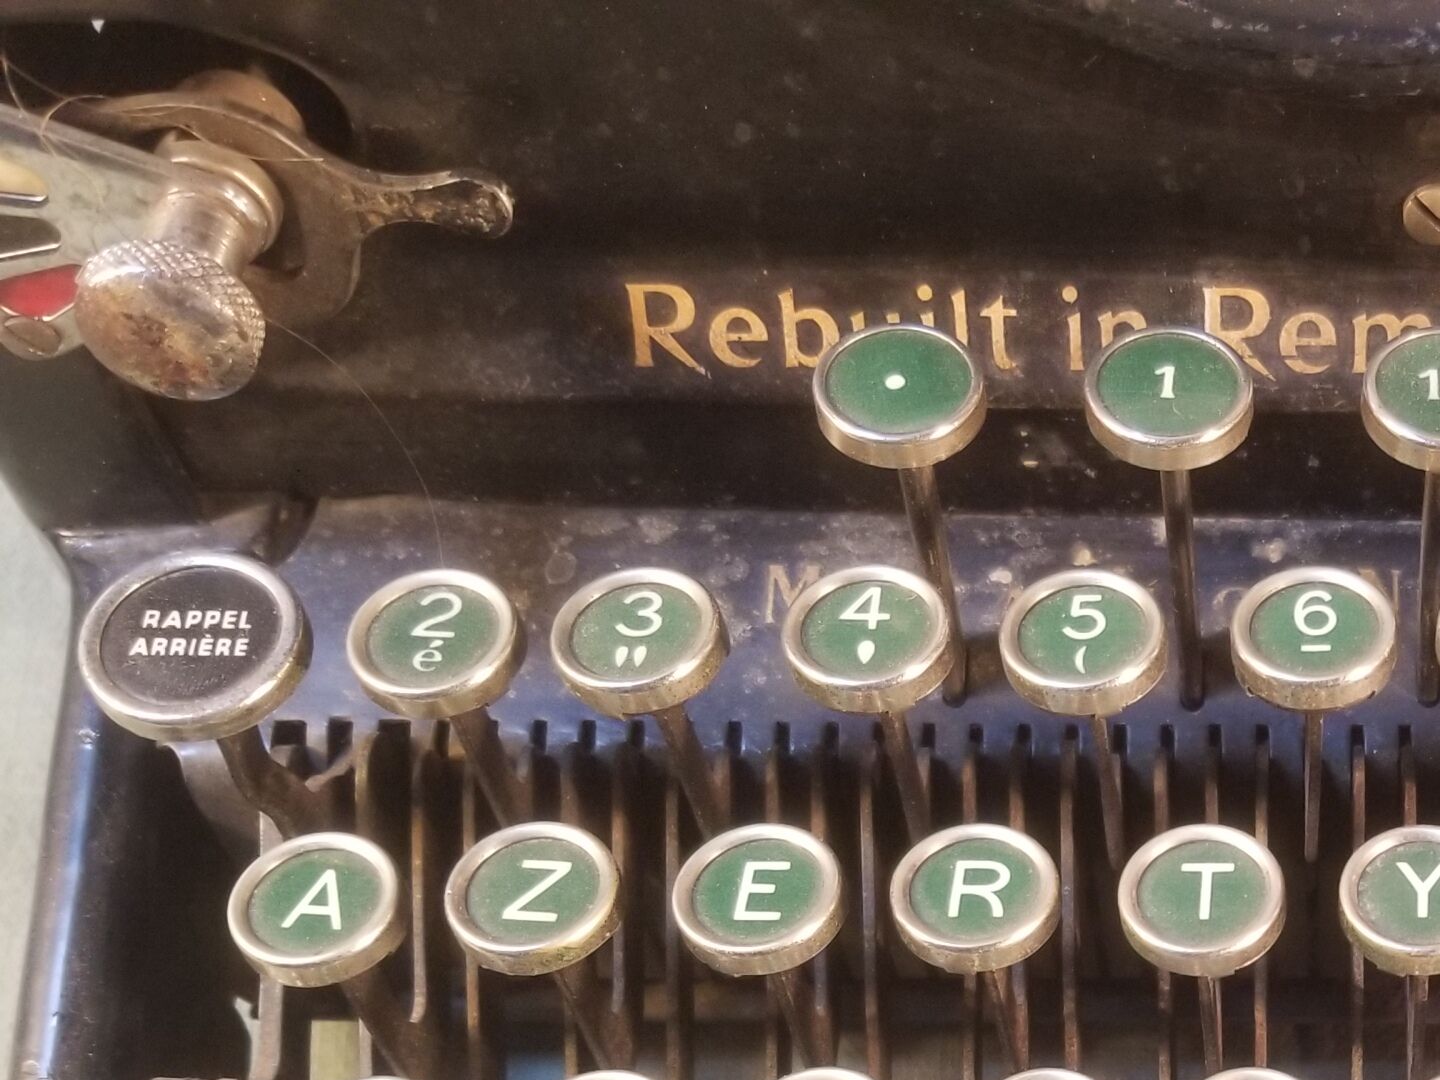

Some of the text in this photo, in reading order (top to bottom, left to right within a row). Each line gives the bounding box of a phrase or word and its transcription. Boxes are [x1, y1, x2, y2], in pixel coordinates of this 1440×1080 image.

[625, 283, 1019, 377] Reblt
[1154, 365, 1176, 400] 1
[142, 610, 252, 629] RAPPEL
[411, 591, 462, 638] 2
[614, 590, 663, 637] 3
[839, 586, 891, 630] 4
[1062, 593, 1106, 640] 5
[1293, 589, 1337, 636] 6
[128, 634, 249, 657] ARRIÈRE
[281, 868, 342, 931] A
[501, 859, 572, 922] Z
[733, 860, 791, 921] E
[947, 859, 1011, 918] R
[1180, 862, 1235, 920] T
